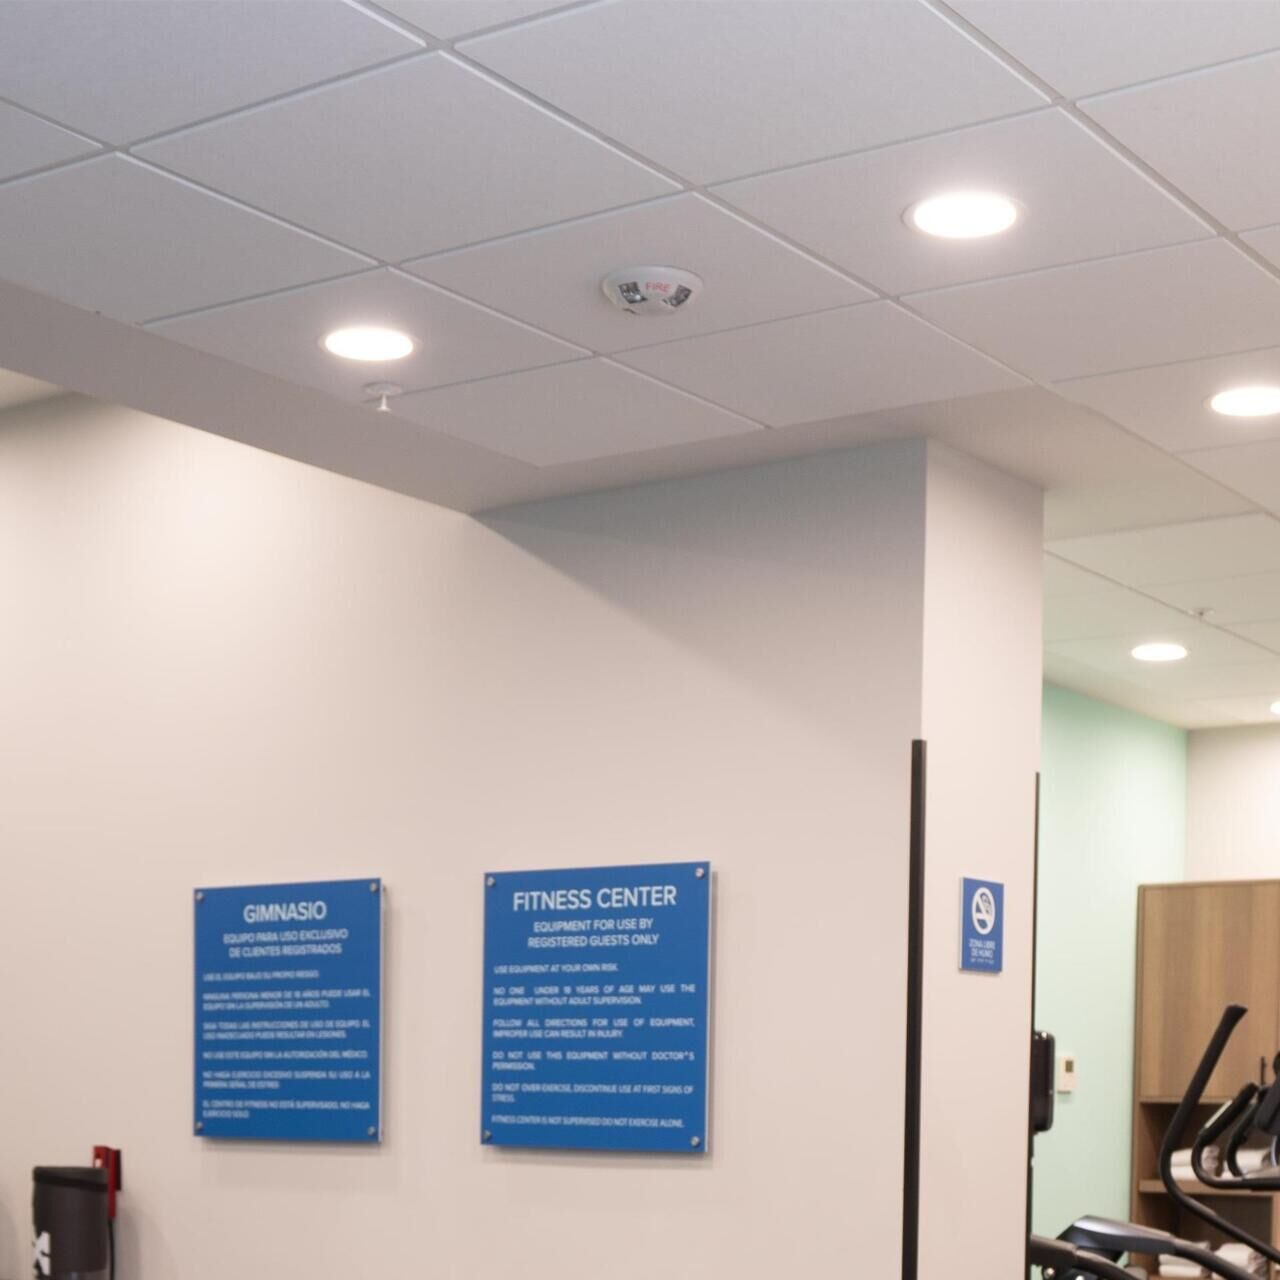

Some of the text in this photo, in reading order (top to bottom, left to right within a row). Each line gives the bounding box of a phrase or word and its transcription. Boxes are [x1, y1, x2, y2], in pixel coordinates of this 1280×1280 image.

[645, 282, 672, 293] FIRE
[512, 884, 677, 911] FITNESS CENTER
[243, 900, 326, 923] GIMNASIO
[533, 917, 652, 932] EQUIPMENT FOR USE BY
[223, 928, 348, 943] EQUIPO PARA USO EXCLUSIVO
[527, 933, 659, 948] REGISTERED GUESTS ONLY
